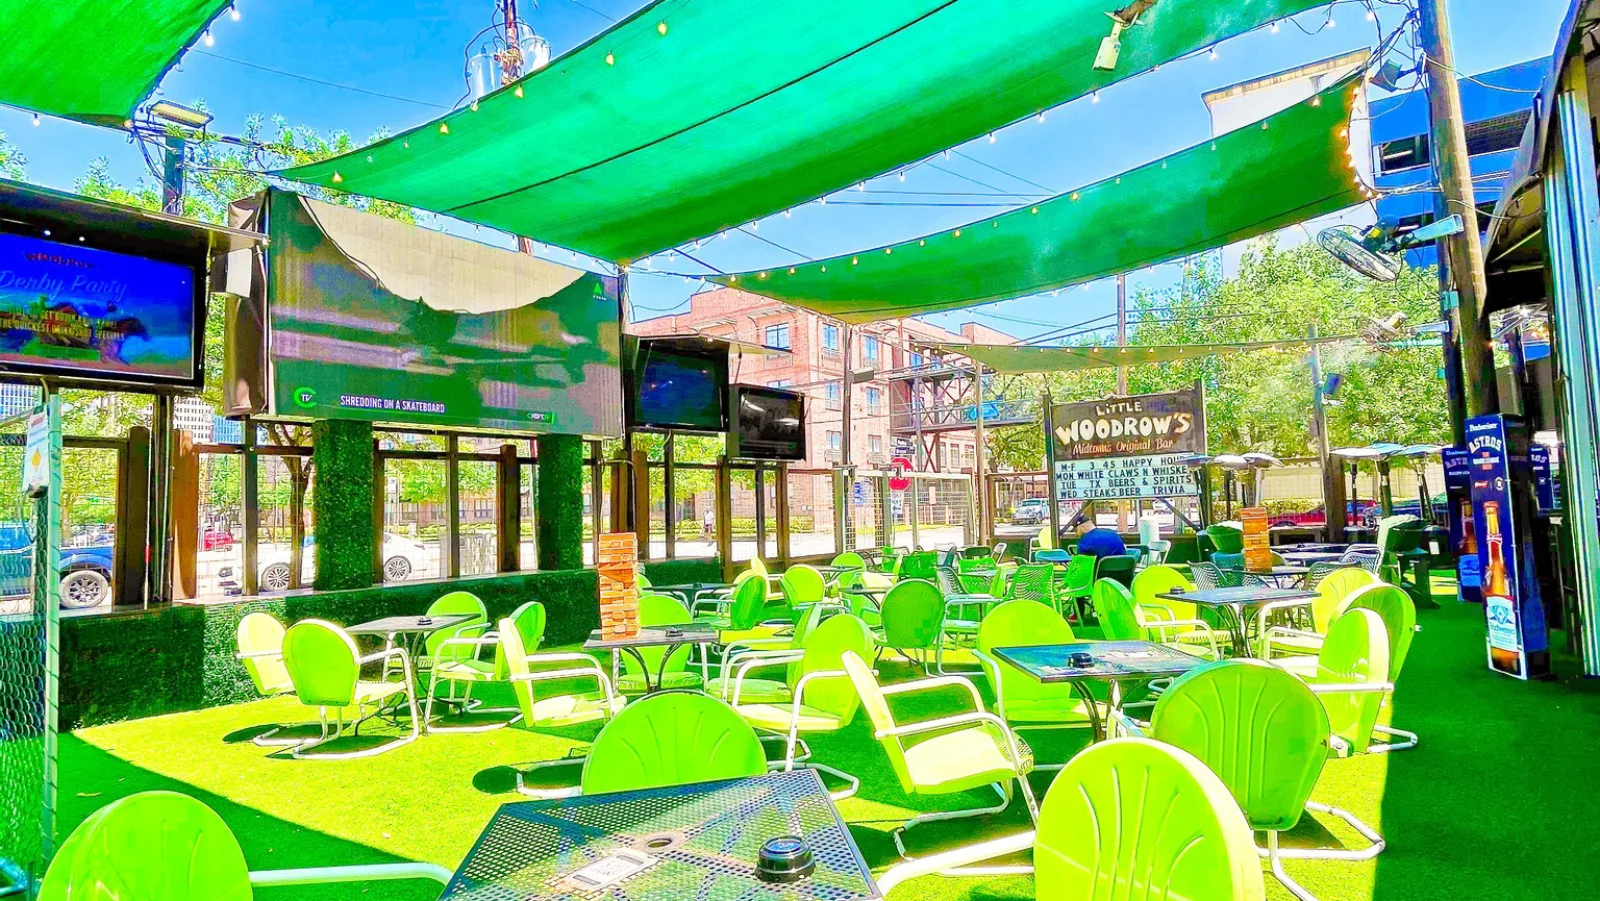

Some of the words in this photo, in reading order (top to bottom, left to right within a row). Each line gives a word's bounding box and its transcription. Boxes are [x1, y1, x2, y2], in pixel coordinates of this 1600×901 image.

[0, 270, 64, 301] Derby
[71, 274, 127, 303] Party
[340, 395, 382, 409] SHREDDING
[383, 399, 394, 410] ON
[395, 400, 401, 411] A
[402, 400, 445, 414] SKATEBOARD
[1054, 412, 1193, 446] WOODROW'S
[1116, 439, 1151, 454] Original
[1154, 437, 1174, 450] Bar
[1468, 435, 1502, 454] ASTROS
[1090, 461, 1095, 470] 3
[1122, 457, 1153, 468] HAPPY
[1056, 471, 1074, 481] MON
[1077, 470, 1104, 480] WHITE
[1108, 468, 1139, 479] CLAWS
[1143, 467, 1148, 476] N
[1152, 465, 1188, 476] WHISKE
[1061, 481, 1077, 490] TUE
[1090, 480, 1101, 489] TX
[1108, 478, 1136, 488] BEERS
[1142, 477, 1149, 486] &
[1153, 474, 1192, 485] SPIRITS
[1060, 490, 1078, 500] WED
[1083, 488, 1117, 498] STEAKS
[1119, 486, 1141, 497] BEER
[1152, 484, 1185, 495] TRIVIA
